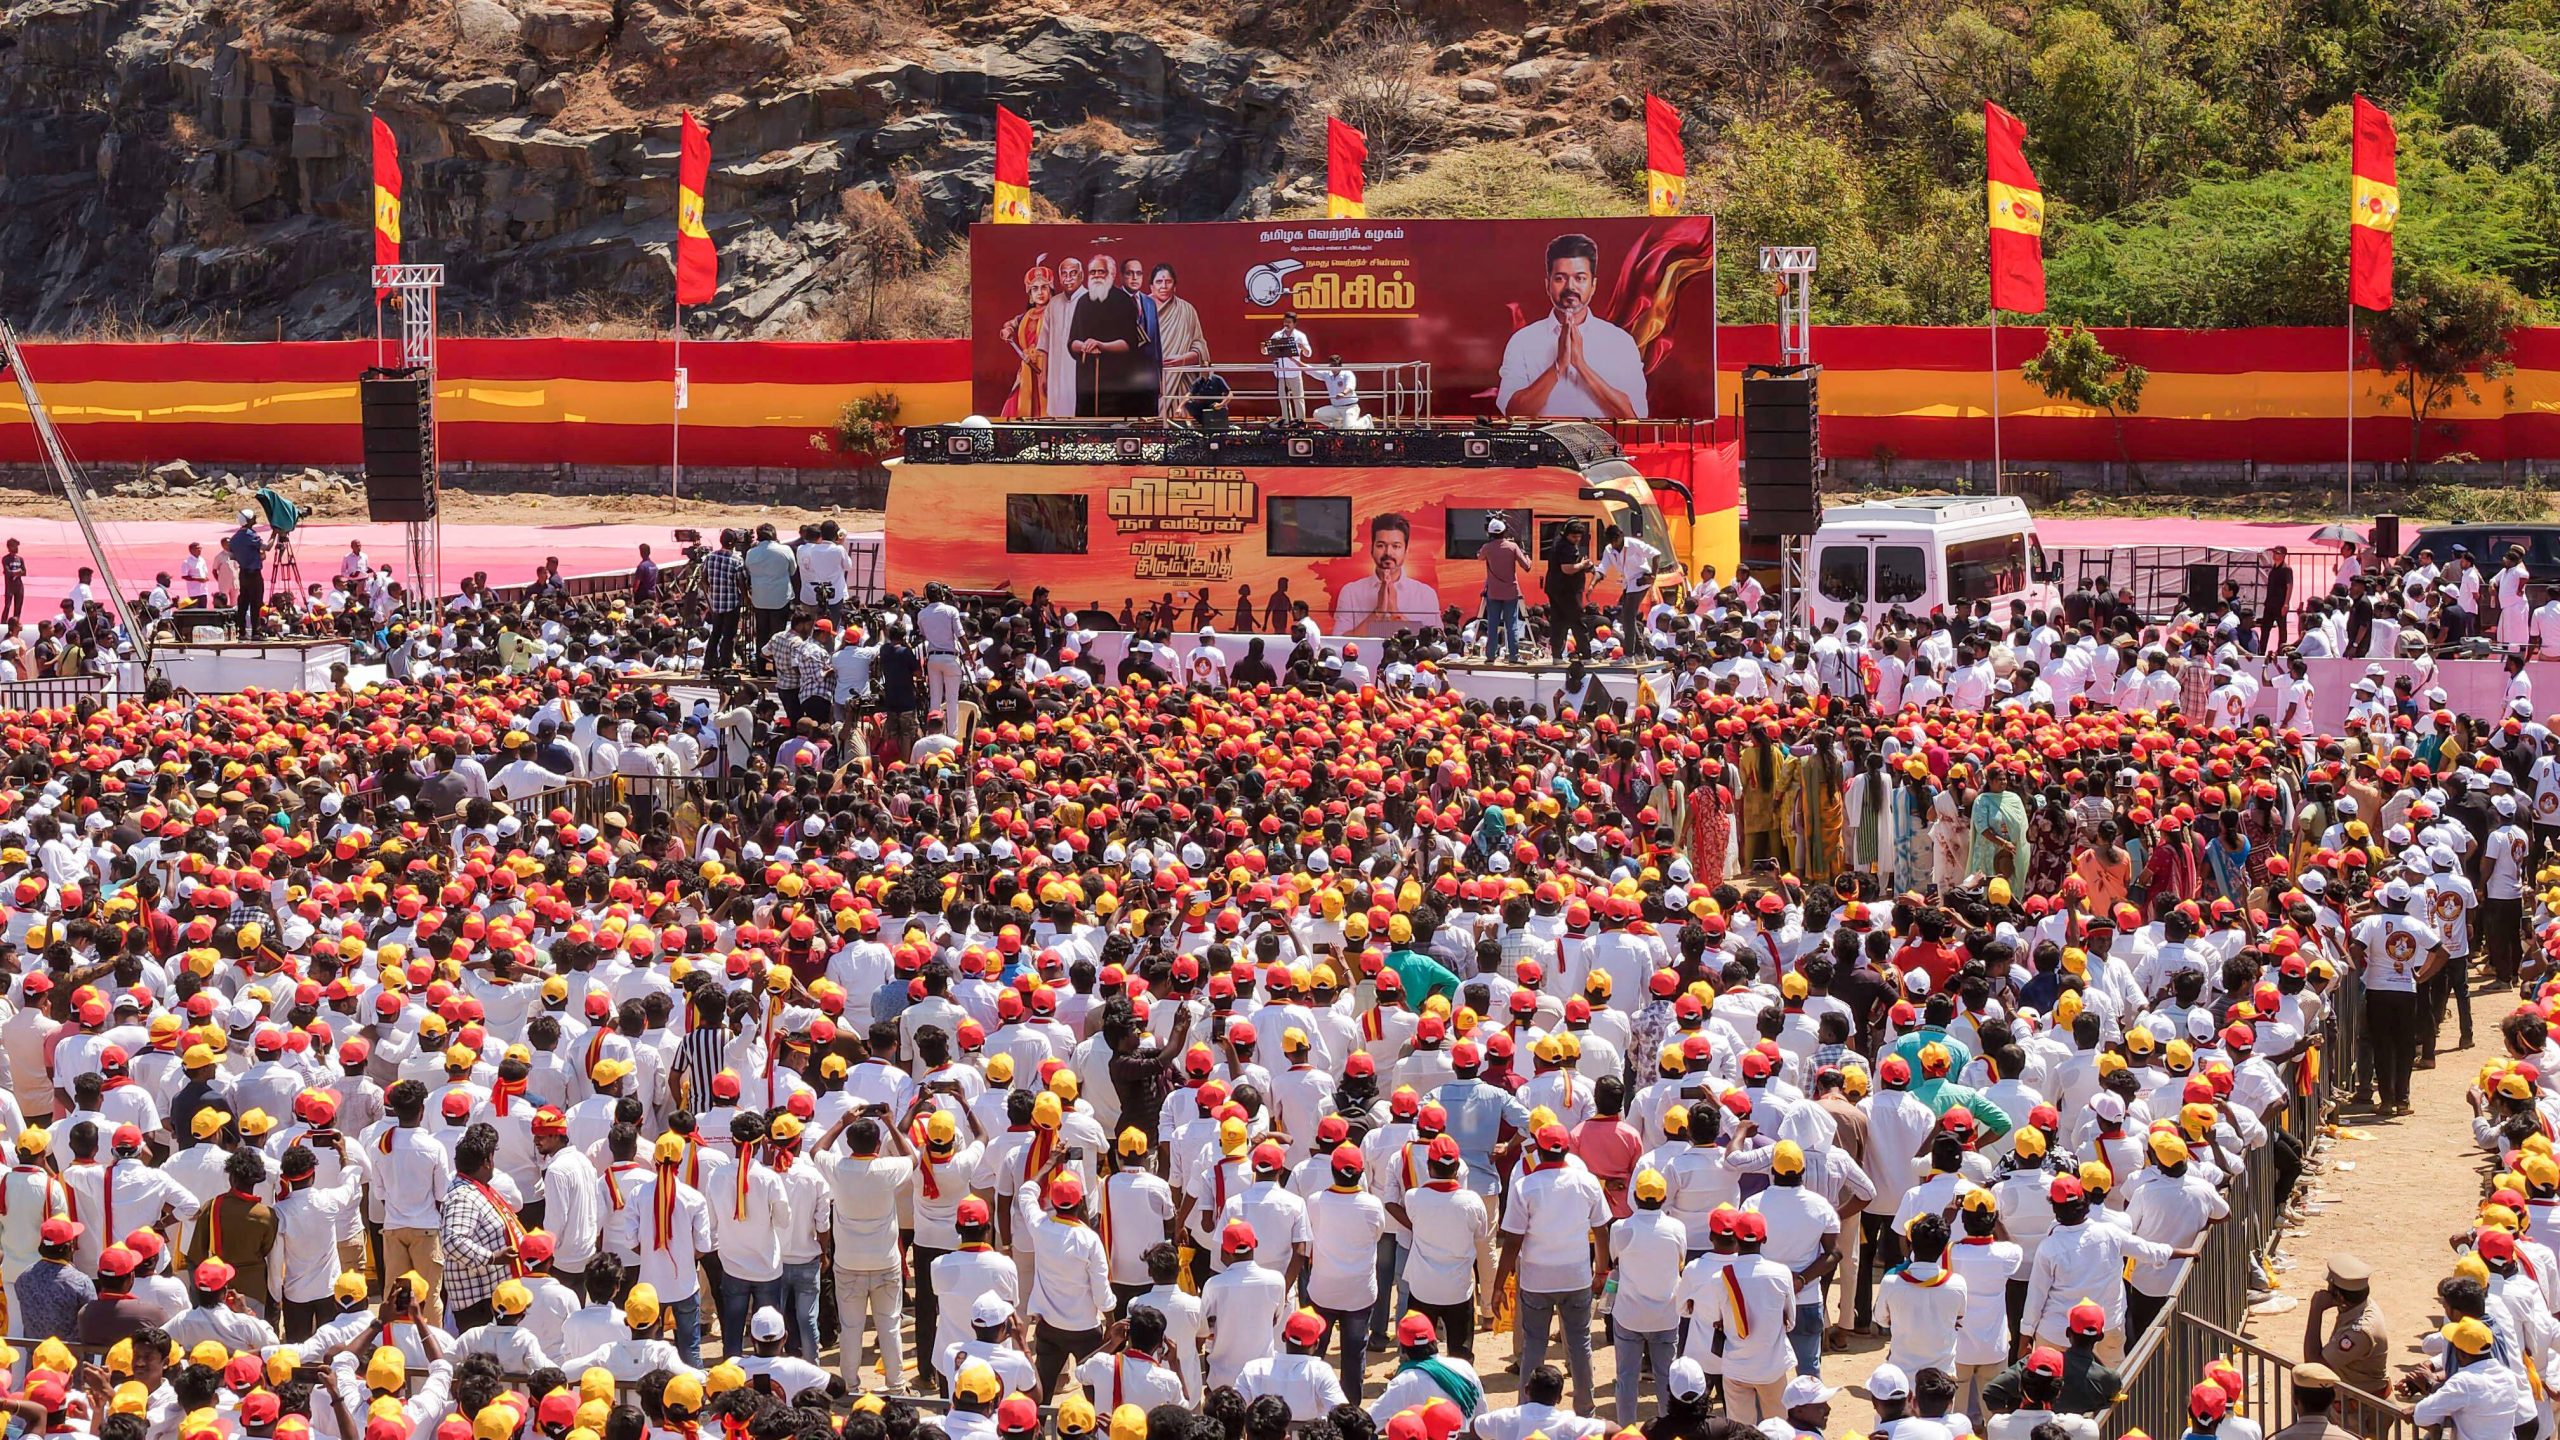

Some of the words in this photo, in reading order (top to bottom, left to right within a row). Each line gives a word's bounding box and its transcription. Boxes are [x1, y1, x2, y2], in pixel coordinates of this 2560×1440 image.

[1259, 228, 1304, 244] தமிழக
[1307, 227, 1361, 242] வெற்றிக்
[1364, 227, 1405, 242] கழகம்
[1292, 270, 1416, 310] விசில்
[1167, 467, 1245, 481] உங்க
[1108, 477, 1255, 518] விஜய்
[1117, 518, 1154, 532] நா
[1159, 517, 1245, 533] வரேன்
[1131, 540, 1199, 561] வரலாறு
